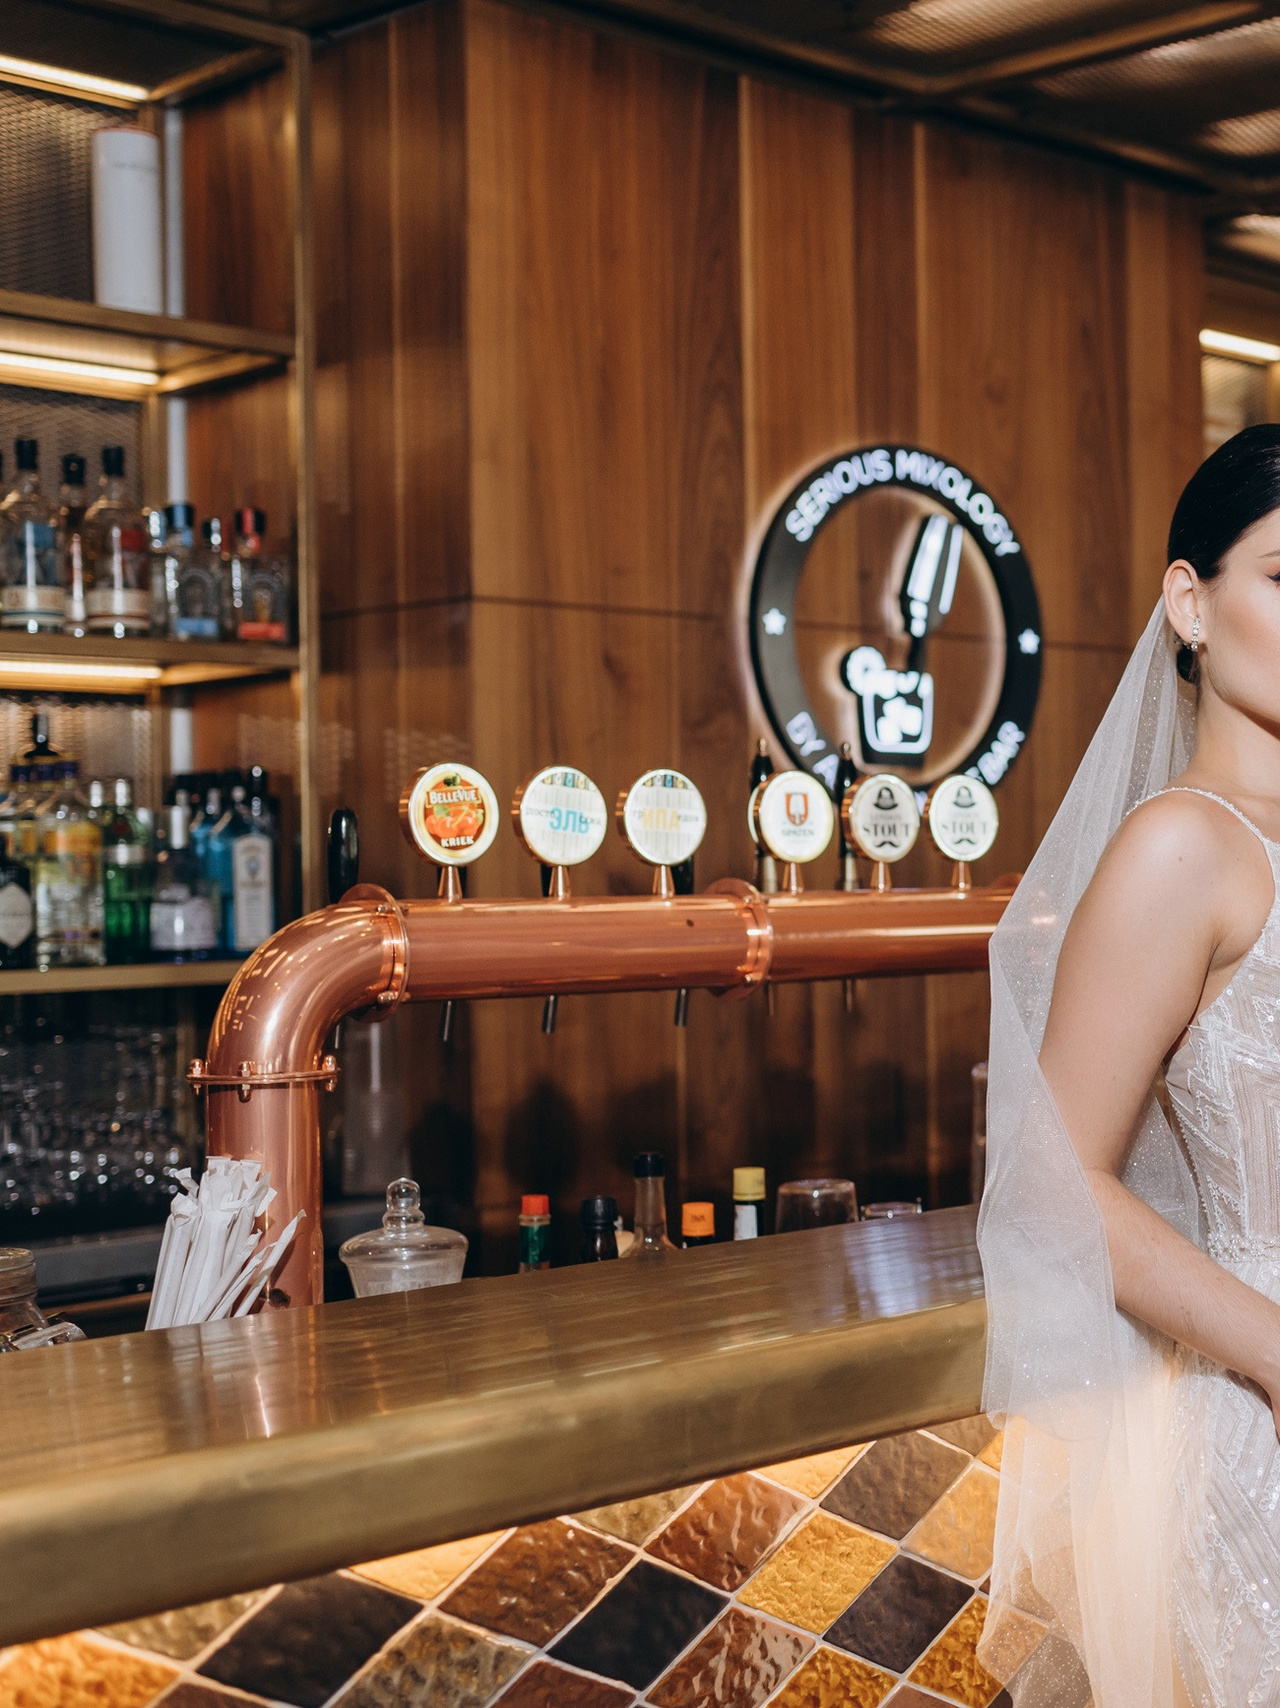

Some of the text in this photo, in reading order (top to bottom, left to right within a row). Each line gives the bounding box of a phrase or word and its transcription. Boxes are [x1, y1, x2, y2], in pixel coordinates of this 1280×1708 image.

[785, 449, 1020, 556] SERIOUS MIXOLOGY
[786, 711, 826, 756] BY
[441, 836, 474, 848] KRIEK
[862, 822, 911, 837] STOUT
